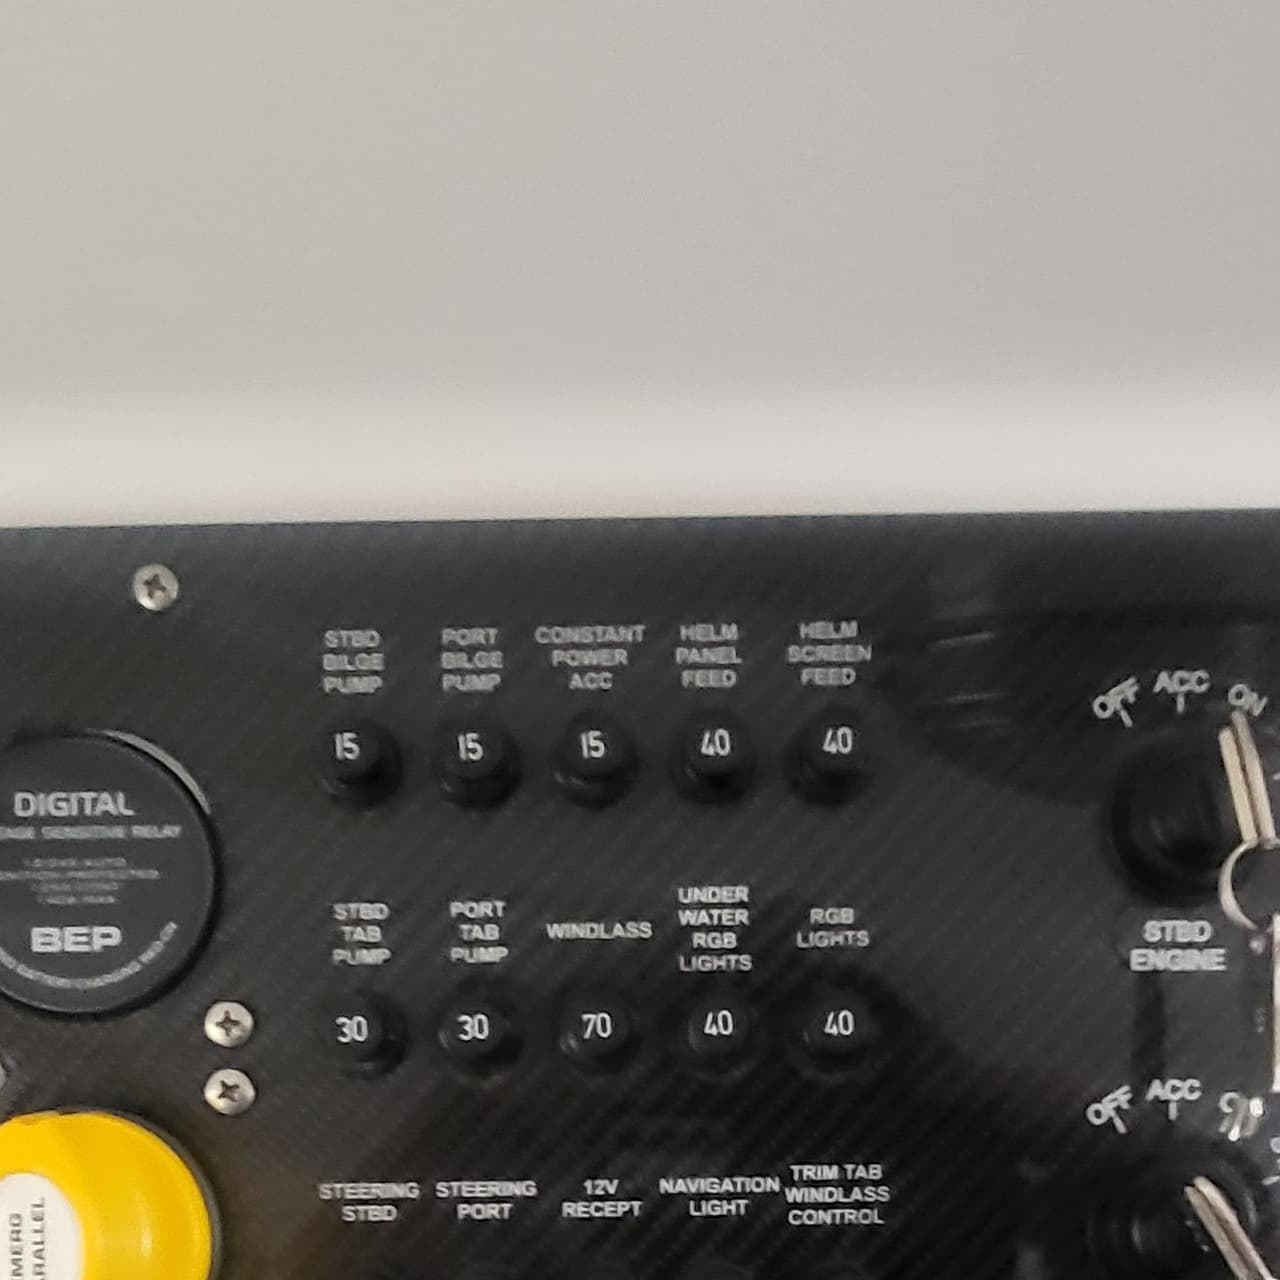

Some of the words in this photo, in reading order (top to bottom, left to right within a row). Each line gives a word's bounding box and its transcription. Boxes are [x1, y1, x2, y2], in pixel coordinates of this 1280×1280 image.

[324, 630, 379, 648] STBD
[442, 628, 499, 646] PORT
[535, 625, 646, 644] CONSTANT
[680, 623, 738, 642] HELM
[800, 621, 858, 639] HELM
[322, 652, 385, 671] BILGE
[442, 651, 503, 670] BILGE
[552, 649, 628, 667] POWER
[676, 646, 742, 665] PANEL
[788, 644, 872, 664] SCREEN
[323, 675, 383, 693] PUMP
[442, 673, 502, 692] PUMP
[569, 672, 613, 689] ACC
[682, 669, 737, 687] FEED
[801, 667, 856, 685] FEED
[1153, 670, 1210, 693] ACC
[1228, 683, 1268, 716] ON
[335, 733, 360, 759] 15
[457, 733, 483, 761] 15
[580, 732, 605, 758] 15
[700, 729, 731, 756] 40
[823, 726, 853, 754] 40
[14, 792, 135, 817] DIGITAL
[678, 885, 749, 903] UNDER
[334, 902, 389, 920] STBD
[450, 900, 506, 919] PORT
[679, 909, 749, 926] WATER
[810, 907, 854, 925] RGB
[30, 926, 121, 952] BEP
[343, 925, 381, 943] TAB
[459, 923, 500, 942] TAB
[546, 921, 652, 940] WINDLASS
[692, 931, 738, 948] RGB
[797, 930, 869, 948] LIGHTS
[1143, 920, 1212, 943] STBD
[333, 947, 391, 966] PUMP
[450, 946, 508, 964] PUMP
[679, 954, 752, 972] LIGHTS
[1130, 949, 1227, 971] ENGINE
[336, 1016, 368, 1043] 30
[457, 1014, 489, 1040] 30
[581, 1012, 612, 1038] 70
[703, 1010, 733, 1037] 40
[825, 1010, 855, 1036] 40
[1145, 1079, 1202, 1101] ACC
[1086, 1085, 1133, 1125] OFF
[790, 1165, 839, 1181] TRIM
[843, 1164, 882, 1181] TAB
[320, 1182, 420, 1200] STEERING
[436, 1180, 537, 1198] STEERING
[583, 1179, 619, 1196] 12V
[659, 1176, 780, 1195] NAVIGATION
[784, 1186, 890, 1203] WINDLASS
[341, 1203, 398, 1221] STBD
[457, 1202, 513, 1220] PORT
[562, 1200, 643, 1218] RECEPT
[689, 1200, 749, 1217] LIGHT
[788, 1207, 884, 1225] CONTROL
